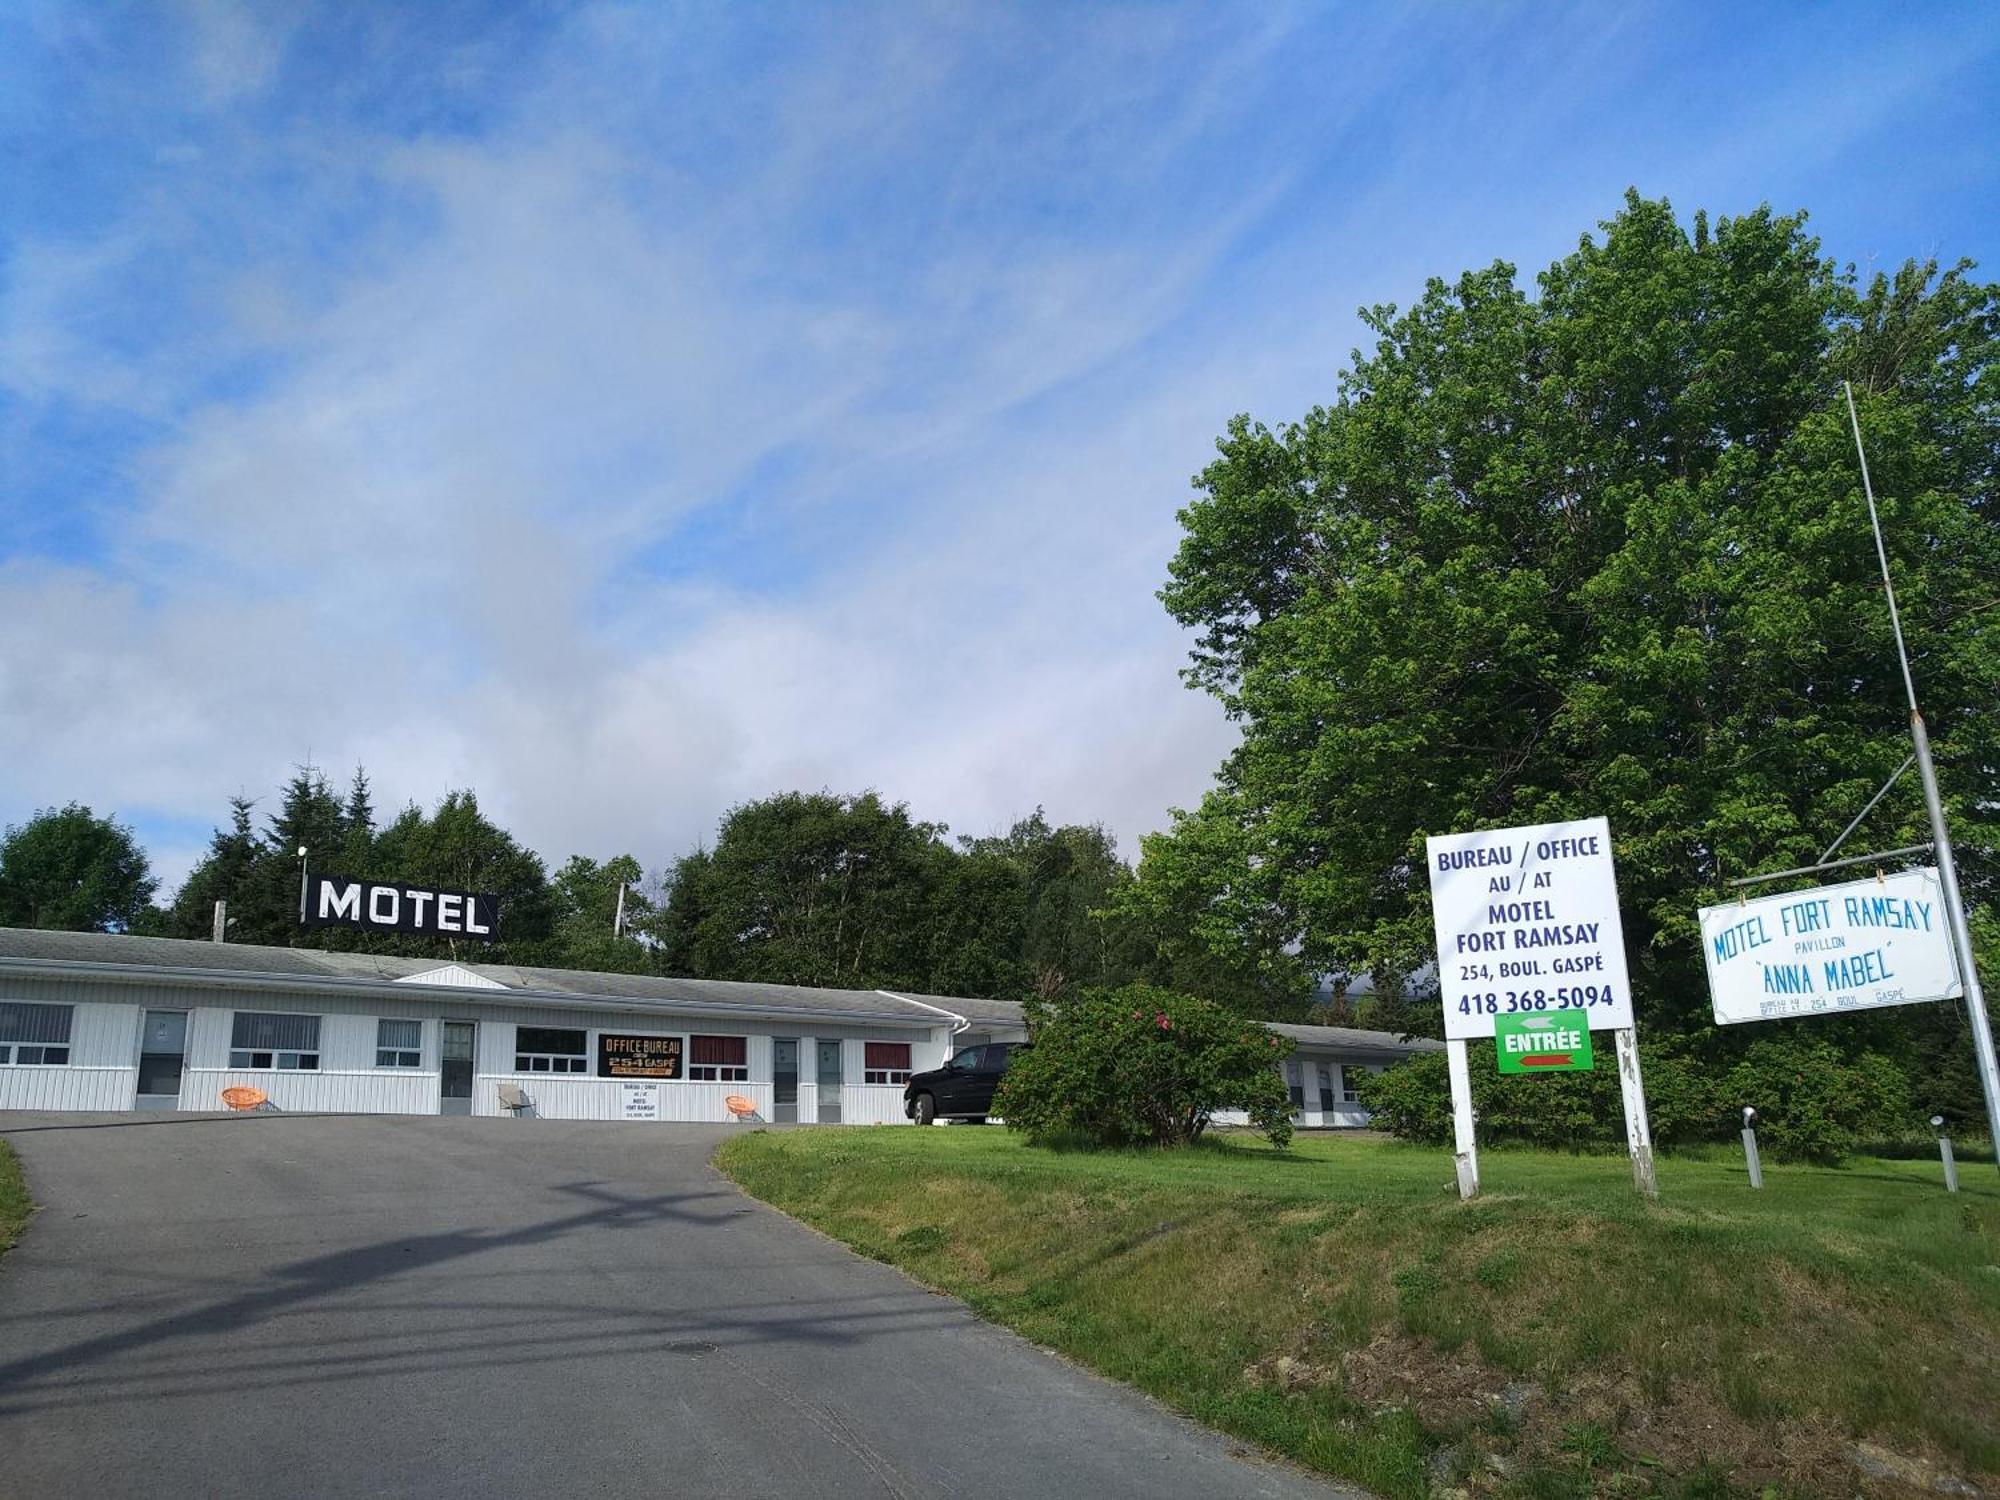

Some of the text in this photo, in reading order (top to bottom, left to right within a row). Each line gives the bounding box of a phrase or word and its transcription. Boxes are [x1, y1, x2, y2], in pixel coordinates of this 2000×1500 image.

[1438, 836, 1600, 871] BUREAU / OFFICE
[1489, 871, 1552, 894] AU / AT
[318, 880, 490, 934] MOTEL
[1488, 900, 1555, 925] MOTEL
[1456, 923, 1600, 954] FORT RAMSAY
[1714, 896, 1933, 965] MOTEL FORT RAMSAY
[1794, 936, 1846, 955] PAVILLON
[1460, 951, 1604, 981] 254, BOUL. GASPÉ
[1458, 985, 1613, 1015] 418 368-5094
[606, 1038, 681, 1054] OFFICE BUREAU
[1504, 1027, 1582, 1053] ENTRÉE
[608, 1057, 643, 1067] 254
